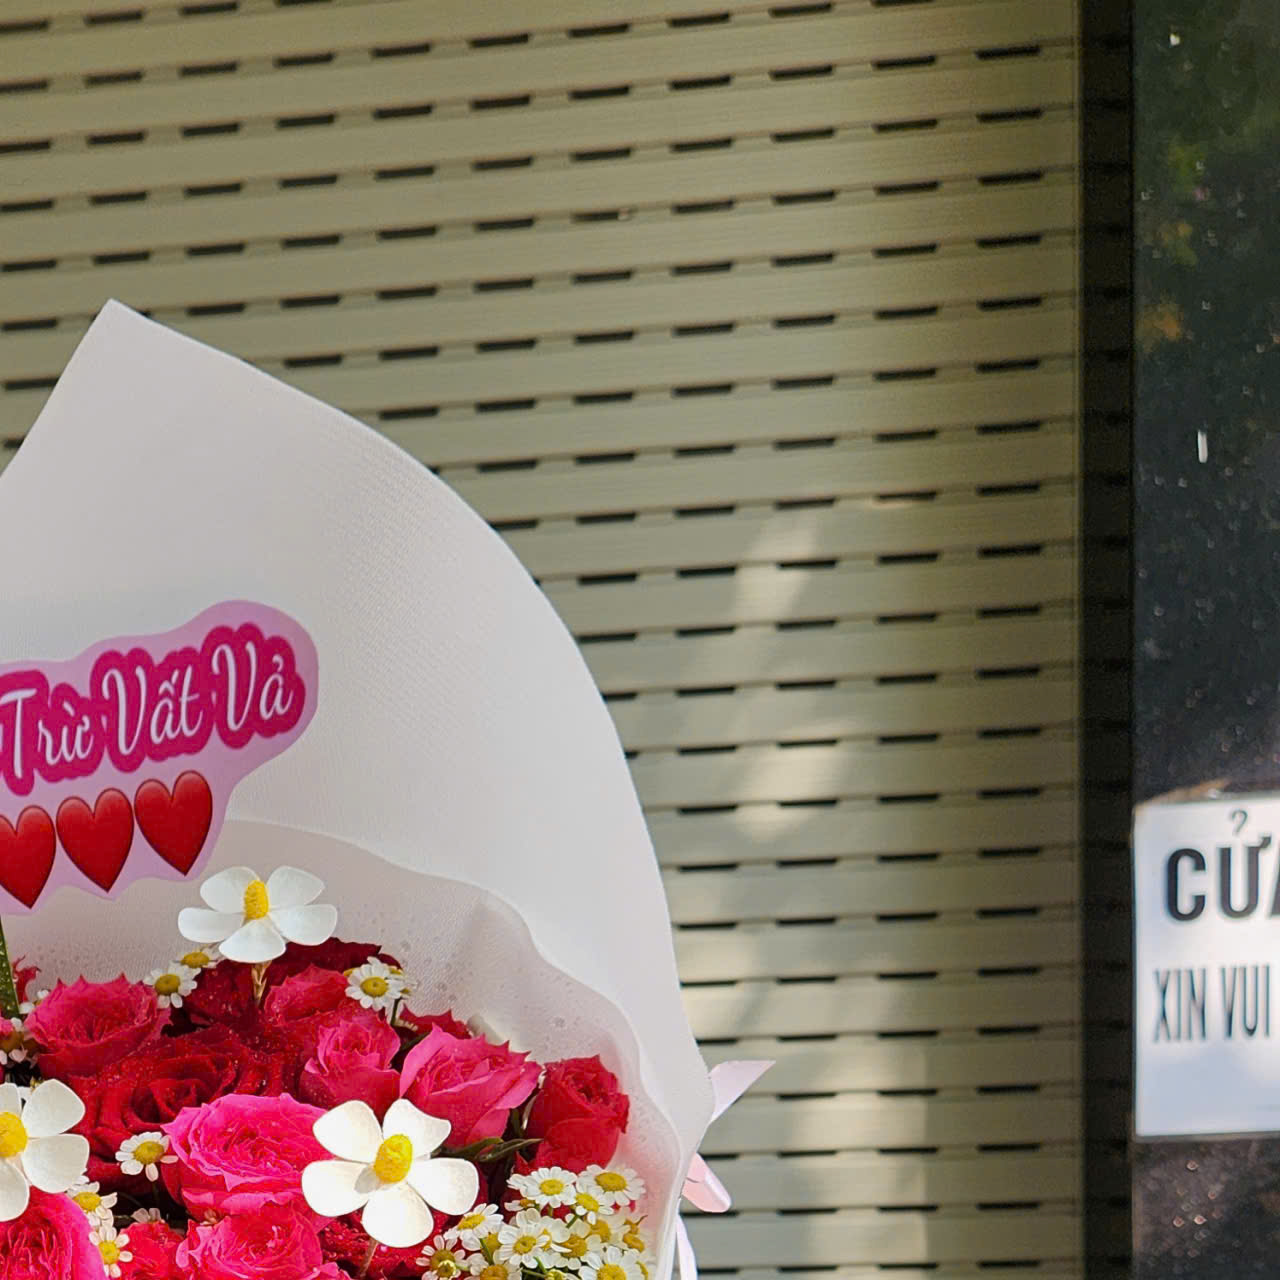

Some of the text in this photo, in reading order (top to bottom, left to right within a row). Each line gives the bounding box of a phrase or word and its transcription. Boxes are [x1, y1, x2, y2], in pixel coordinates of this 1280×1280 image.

[0, 687, 94, 779] Trừ
[101, 664, 203, 756] Vất
[211, 640, 294, 732] Vả
[1166, 809, 1280, 922] CỬ
[1152, 964, 1271, 1044] XIN VUI
